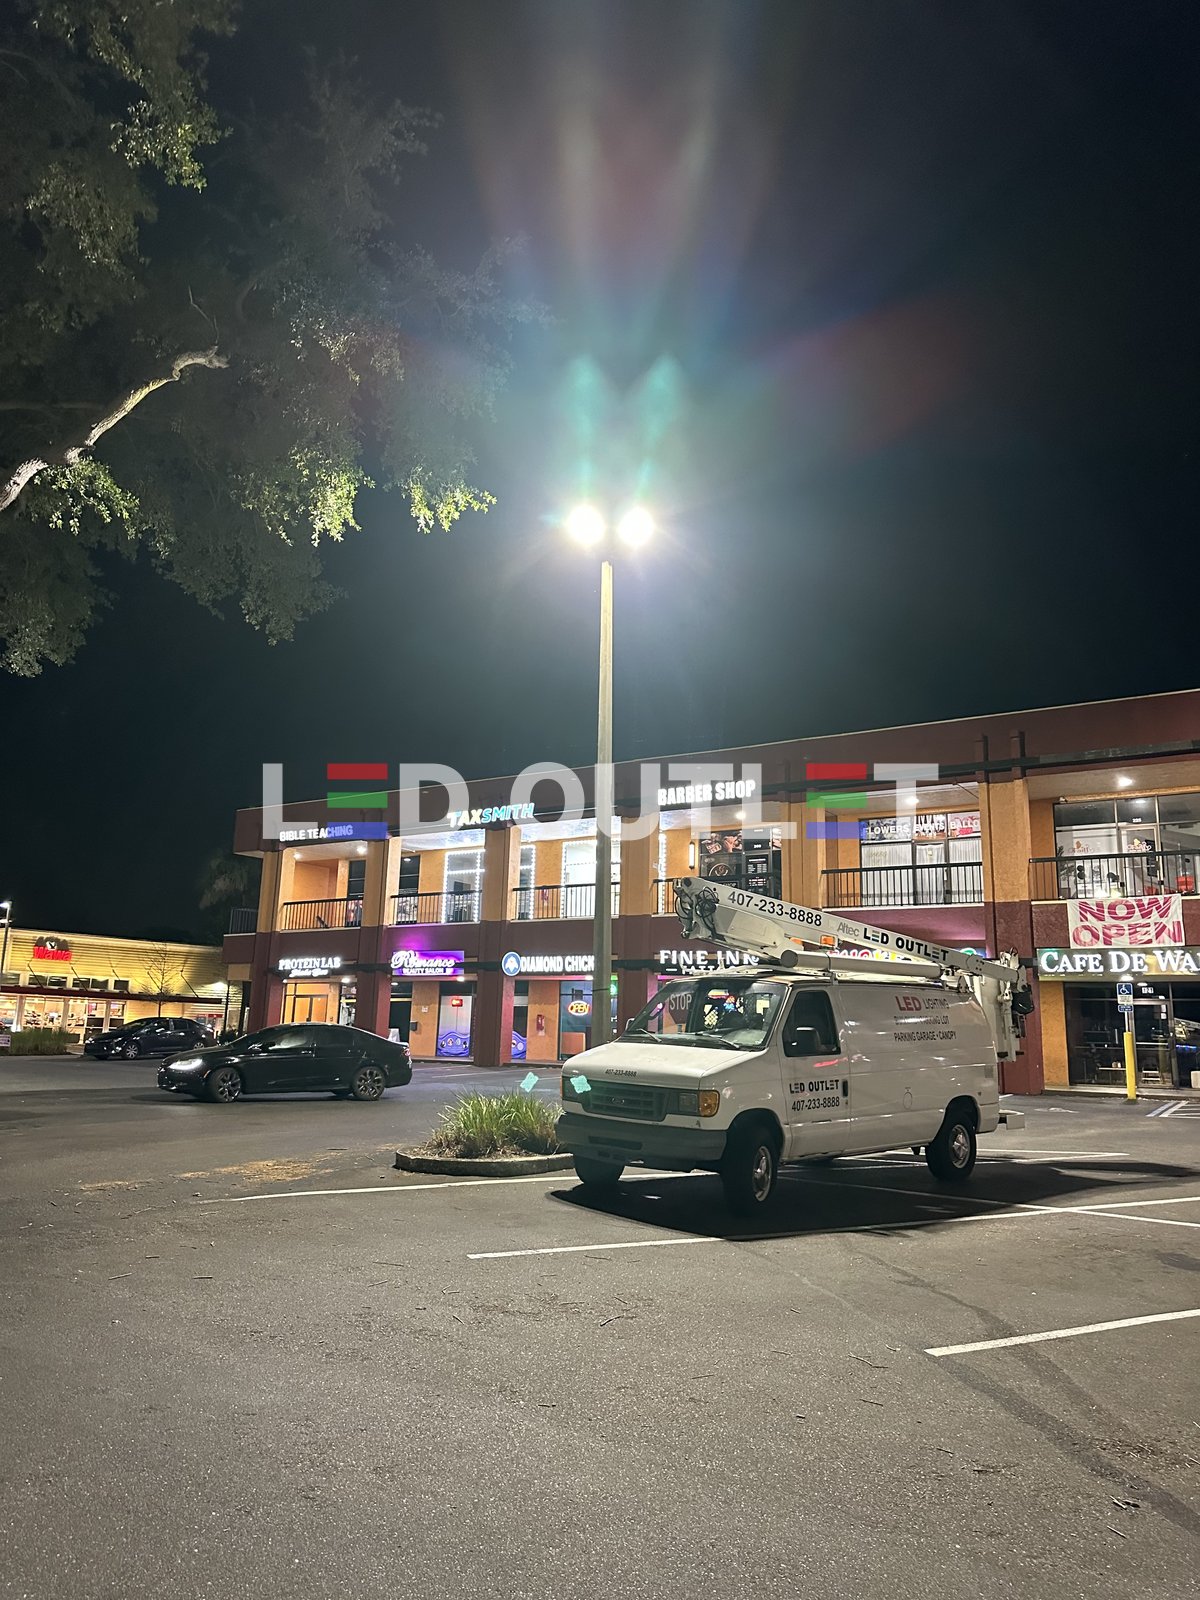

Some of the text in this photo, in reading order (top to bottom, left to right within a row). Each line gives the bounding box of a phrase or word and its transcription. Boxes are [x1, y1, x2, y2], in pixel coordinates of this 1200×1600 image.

[658, 780, 756, 805] BARBER SHOP
[447, 803, 535, 827] TAXSMITH
[279, 825, 353, 841] BIBLE TEACHING
[863, 825, 910, 838] FLOWERS
[915, 822, 945, 833] EVENTS
[728, 891, 822, 926] 407-233-8888
[1079, 896, 1172, 922] NOW
[837, 922, 860, 937] Altec
[1072, 921, 1183, 946] OPEN
[863, 928, 889, 944] LED
[896, 937, 949, 962] OUTLET
[33, 946, 73, 961] Wawa
[391, 950, 456, 969] Romance
[659, 950, 709, 965] FINE
[1153, 950, 1200, 972] WA
[520, 956, 563, 972] DIAMOND
[570, 1003, 590, 1013] OPEN
[669, 993, 692, 1010] STOP
[895, 996, 949, 1011] LED LIGHTING
[941, 1016, 950, 1024] LOT
[894, 1031, 957, 1041] PARKING GARAGE CANOPY
[789, 1080, 839, 1094] LED OUTLET
[792, 1096, 840, 1111] 407-233-8888
